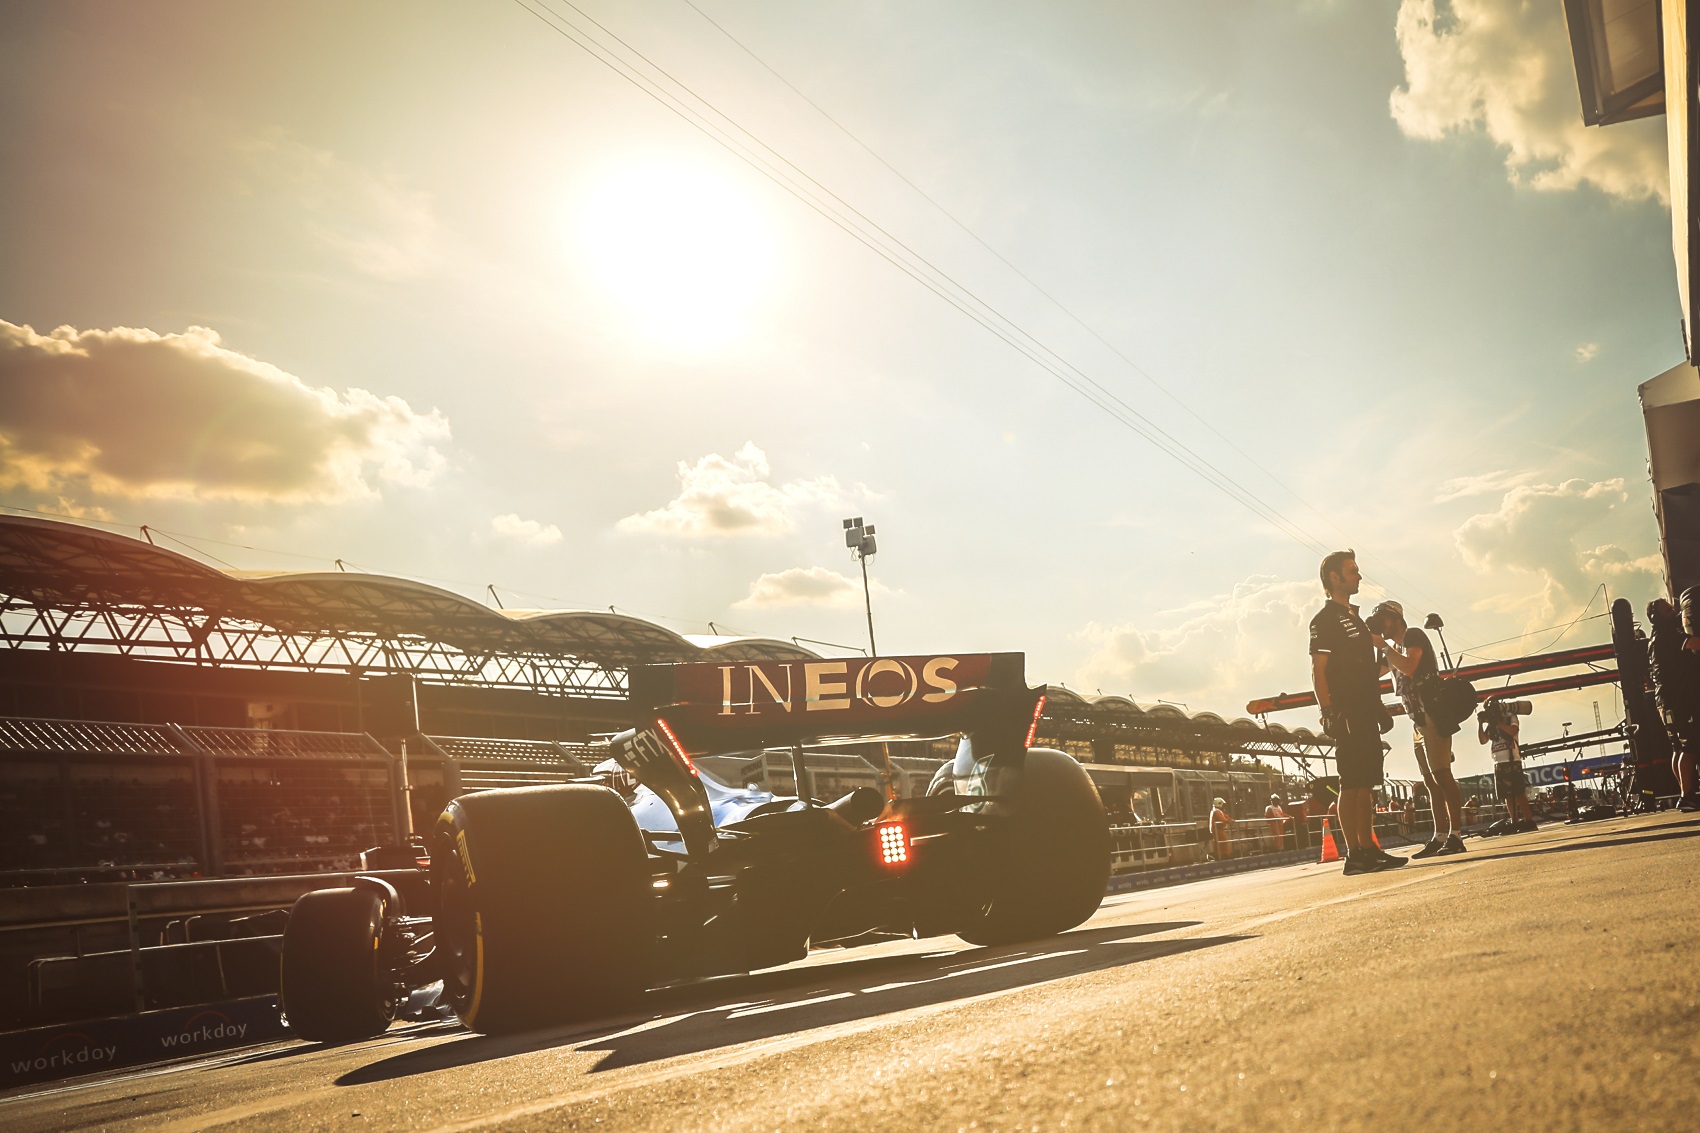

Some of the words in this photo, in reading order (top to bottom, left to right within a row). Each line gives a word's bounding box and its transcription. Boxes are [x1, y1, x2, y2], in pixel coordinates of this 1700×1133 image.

[717, 657, 959, 716] INEOS
[632, 727, 670, 763] FTX
[160, 1021, 248, 1048] workday
[10, 1044, 117, 1075] workday
